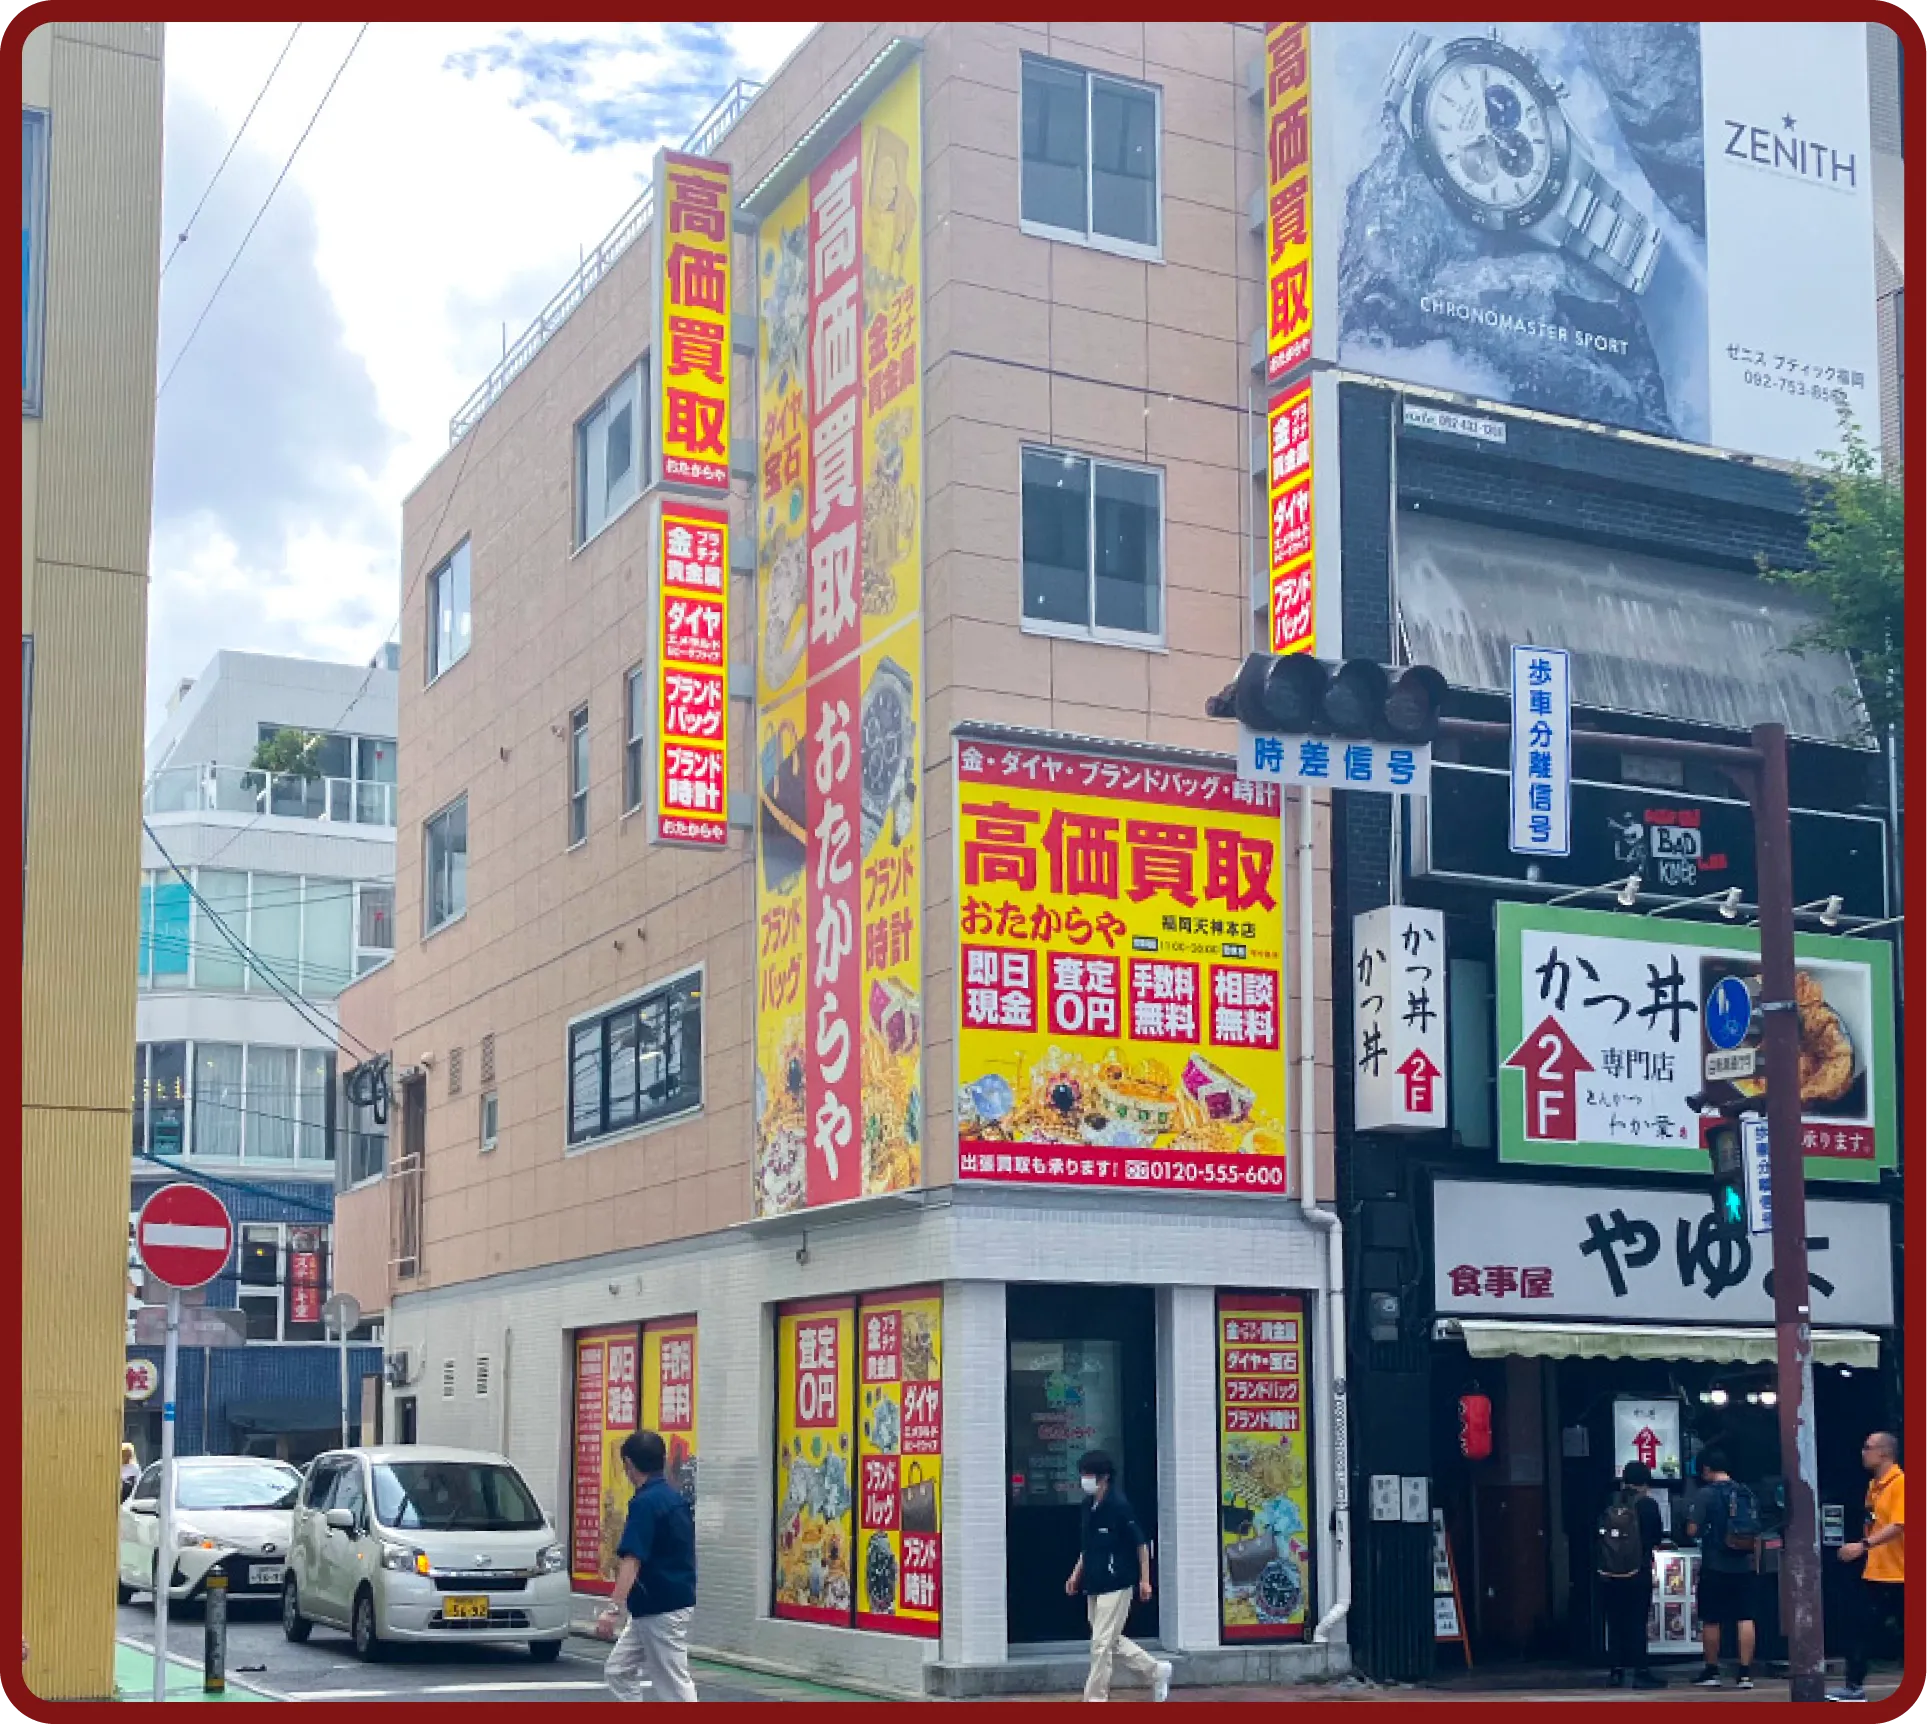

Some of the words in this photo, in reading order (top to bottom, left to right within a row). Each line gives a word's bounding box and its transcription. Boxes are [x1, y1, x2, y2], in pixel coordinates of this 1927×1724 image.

[1724, 119, 1857, 187] ZENITH
[1268, 22, 1310, 340] 高価買取
[667, 172, 728, 456] 高価買取
[1420, 296, 1567, 342] CHRONOMASTER
[1574, 330, 1629, 356] SPORT
[764, 388, 803, 452] ダイヤ
[811, 156, 858, 645] 高価買取
[665, 458, 727, 483] おたからや
[764, 434, 801, 502] 宝石
[1273, 490, 1309, 537] ダイヤ
[666, 526, 693, 557] 金
[666, 601, 722, 639] ダイヤ
[665, 673, 722, 708] ブランド
[666, 704, 721, 736] バッグ
[665, 747, 722, 779] ブランド
[1254, 736, 1417, 785] 時差信号
[1528, 658, 1553, 844] 歩車分離信号
[667, 778, 721, 810] 時計
[662, 821, 725, 840] おたからや
[1657, 827, 1697, 855] BAD
[864, 844, 915, 913] ブランド
[961, 800, 1277, 913] 高価買取
[761, 896, 803, 959] ブランド
[814, 700, 854, 1181] おたからや
[864, 905, 914, 973] 時計
[960, 895, 1127, 949] おたからや
[761, 951, 803, 1013] バッグ
[967, 950, 1030, 989] 即日
[1052, 956, 1117, 995] 査定
[1132, 963, 1195, 1001] 手数料
[1214, 968, 1274, 1008] 相談
[1401, 921, 1437, 1034] かつ丼
[967, 987, 1032, 1027] 現金
[1357, 946, 1388, 1077] かつ丼
[1535, 945, 1699, 1043] かつ丼
[1134, 1001, 1195, 1039] 無料
[1215, 1008, 1274, 1044] 無料
[1410, 1057, 1427, 1111] 2F
[1537, 1033, 1565, 1136] 2F
[1601, 1047, 1676, 1083] 専門店
[1150, 1160, 1283, 1185] 0120-555-600
[1447, 1263, 1555, 1299] 食事屋
[798, 1325, 836, 1370] 査定
[903, 1384, 939, 1424] ダイヤ
